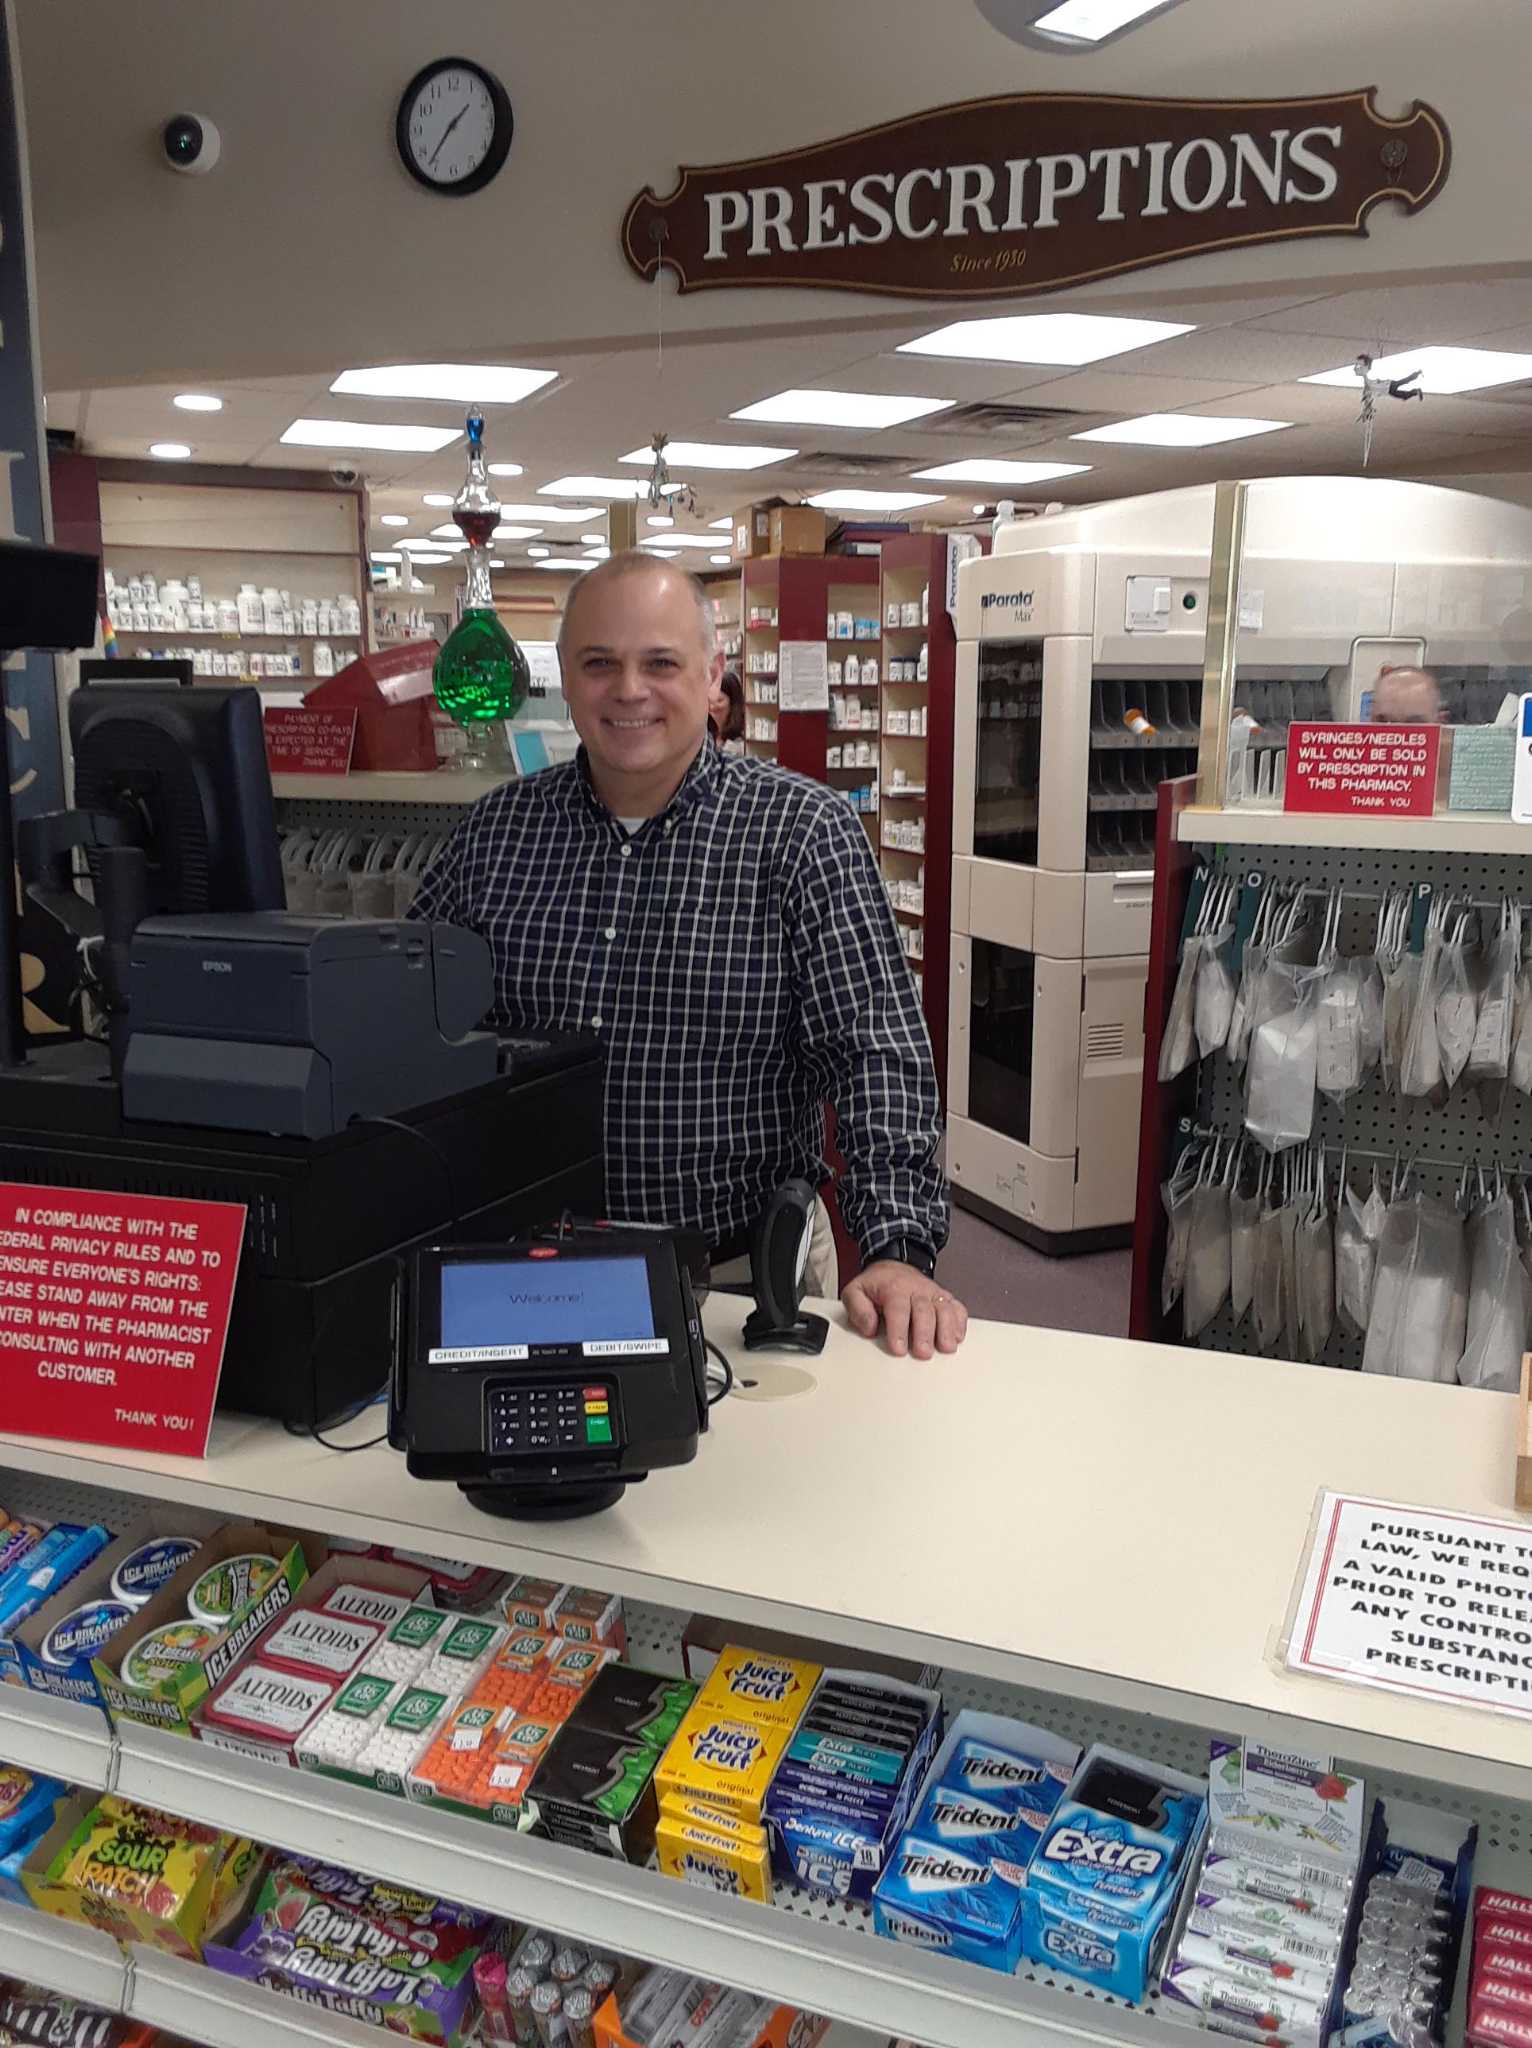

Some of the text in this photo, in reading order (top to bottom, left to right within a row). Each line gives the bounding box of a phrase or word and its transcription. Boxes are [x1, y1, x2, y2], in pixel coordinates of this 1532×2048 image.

[446, 74, 461, 92] 12
[419, 103, 433, 117] 10
[703, 126, 1342, 261] PRESCRIPTIONS
[950, 254, 992, 273] Since
[988, 590, 1034, 608] Parata
[1301, 731, 1427, 746] SYRINGES/NEEDLES
[1298, 747, 1427, 761] WILL ONLY BE SOLD
[1297, 762, 1426, 777] BY PRESCRIPTION IN
[1308, 777, 1413, 793] THIS PHARMACY.
[1351, 796, 1411, 808] THANK YOU
[1194, 867, 1209, 882] N
[1247, 873, 1262, 888] O
[1418, 884, 1432, 899] P
[202, 961, 232, 973] EPSON
[1179, 1118, 1191, 1133] S
[15, 1207, 199, 1241] IN COMPLIANCE WITH THE
[0, 1230, 221, 1268] EDERAL PRIVACY RULES AND TO
[52, 1260, 140, 1285] EVERYONE'S
[0, 1279, 209, 1319] EASE STAND AWAY FROM THE
[0, 1305, 212, 1345] NTER WHEN THE PHARMACIST
[84, 1340, 121, 1360] WITH
[124, 1345, 196, 1369] ANOTHER
[435, 1347, 524, 1361] CREDIT/INSERT
[37, 1360, 118, 1386] CUSTOMER.
[114, 1408, 195, 1431] THANK YOU!
[1370, 1521, 1506, 1554] PURSUANT
[1360, 1539, 1422, 1561] LAW,
[1430, 1550, 1470, 1567] WE
[1343, 1559, 1361, 1571] A
[1370, 1563, 1446, 1585] VALID
[330, 1594, 398, 1623] ALTOID
[1332, 1576, 1532, 1623] PRIOR TO RELE
[1350, 1600, 1410, 1621] ANY
[205, 1643, 236, 1686] ICE
[227, 1578, 292, 1653] BREAKERS
[284, 1620, 366, 1652] ALTOIDS
[735, 1661, 794, 1684] Juicy
[1366, 1648, 1532, 1692] PRESCRIPTI
[234, 1678, 317, 1711] ALTOIDS
[730, 1677, 788, 1701] Fruit
[698, 1724, 761, 1751] Juicy
[693, 1743, 752, 1770] Fruit
[962, 1756, 1047, 1783] Trident
[784, 1817, 833, 1839] Dentyne
[931, 1802, 1019, 1831] Trident
[97, 1838, 168, 1873] SOUR
[796, 1845, 852, 1871] Dentyn
[1043, 1826, 1163, 1875] Extra
[900, 1854, 992, 1885] Trident
[887, 1918, 951, 1947] Trident
[1491, 1925, 1532, 1944] HALL
[1046, 1931, 1116, 1964] Extra
[1491, 1955, 1532, 1974] HALL
[346, 1959, 423, 2005] Laffy
